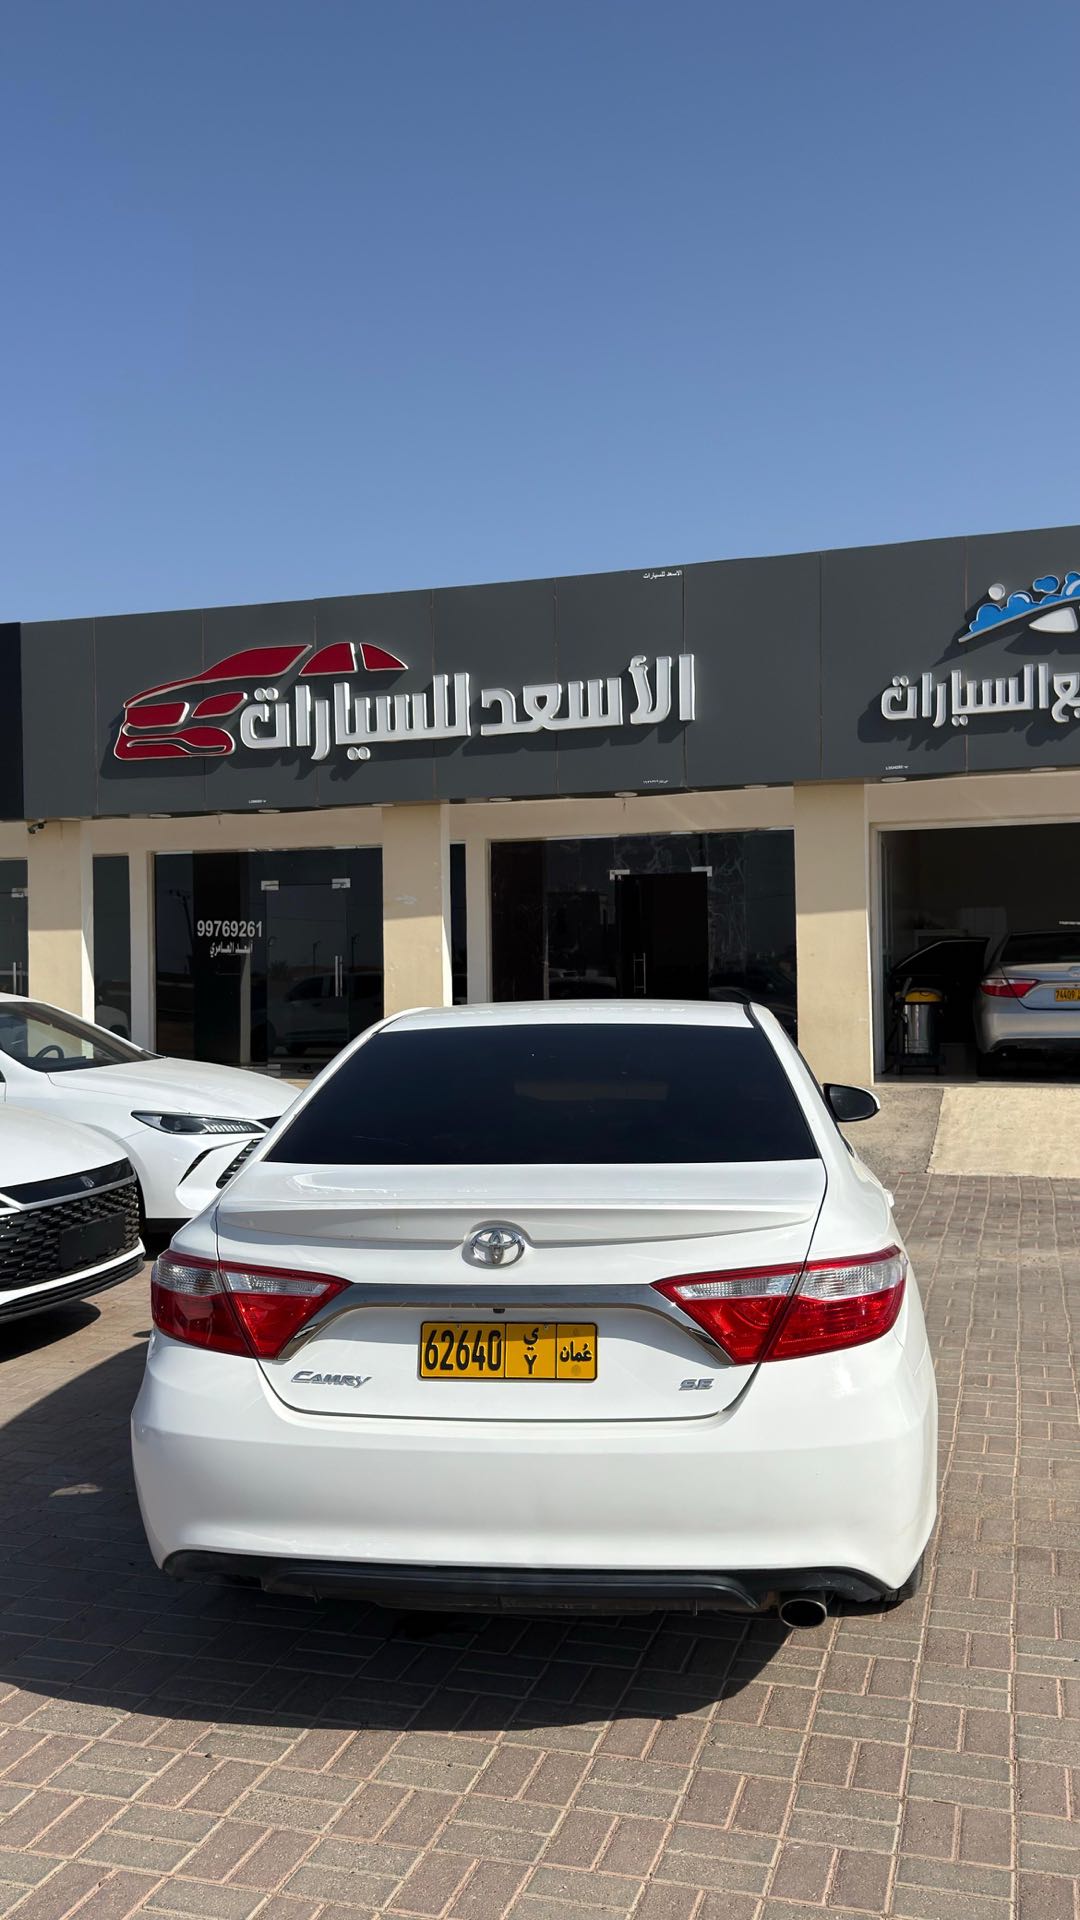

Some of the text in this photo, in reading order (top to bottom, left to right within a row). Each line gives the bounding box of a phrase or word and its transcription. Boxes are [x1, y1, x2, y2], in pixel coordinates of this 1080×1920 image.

[240, 654, 695, 760] الأسعد للسيارات
[881, 663, 1049, 728] السيارات
[197, 920, 262, 937] 99769261
[524, 1327, 539, 1350] ي
[425, 1330, 501, 1371] 62640
[524, 1354, 537, 1374] Y
[679, 1378, 714, 1391] SE
